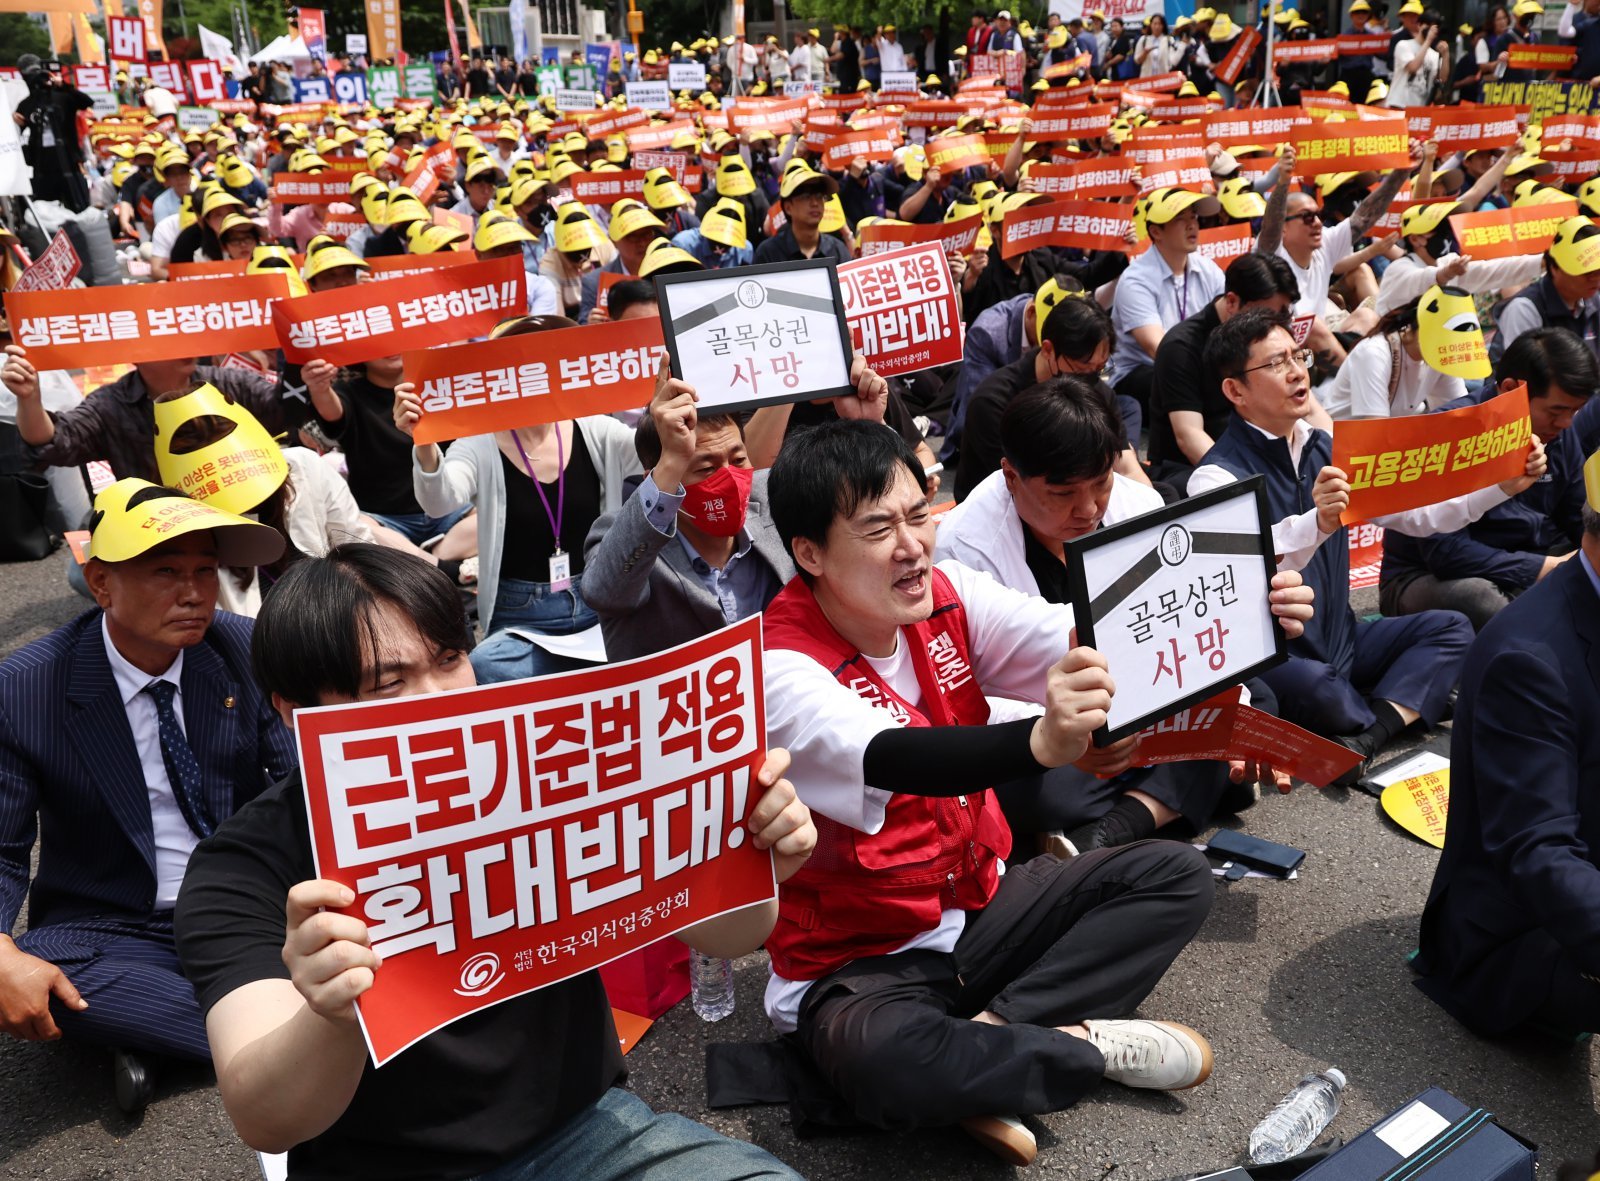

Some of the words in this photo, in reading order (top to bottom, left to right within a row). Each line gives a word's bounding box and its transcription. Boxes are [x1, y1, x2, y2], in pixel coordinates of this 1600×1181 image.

[111, 18, 146, 60] 버
[190, 62, 225, 100] 다
[405, 68, 433, 102] 존
[786, 82, 821, 92] KFME
[1297, 138, 1351, 160] 고용정책
[1007, 216, 1056, 243] 생존권을
[1462, 224, 1514, 247] 고용정책
[900, 254, 942, 297] 적용
[19, 310, 140, 348] 생존권을
[288, 305, 395, 349] 생존권을
[397, 280, 518, 328] 보장하라!!
[705, 315, 812, 356] 골목상권
[420, 361, 550, 413] 생존권을
[1349, 441, 1452, 491] 고용정책
[1451, 415, 1532, 471] 전환하라!!
[183, 461, 217, 488] 이상은
[221, 462, 281, 488] 보장하라!!
[702, 498, 724, 511] 개정
[706, 511, 728, 522] 촉구
[141, 516, 162, 530] 더
[1126, 564, 1239, 644] 골목상권
[342, 690, 643, 850] 근로기준법
[658, 656, 746, 762] 적용
[355, 765, 752, 961] 확대반대!
[536, 886, 692, 966] 한국외식업중앙회
[513, 949, 533, 961] 사단
[513, 959, 534, 973] 법인
